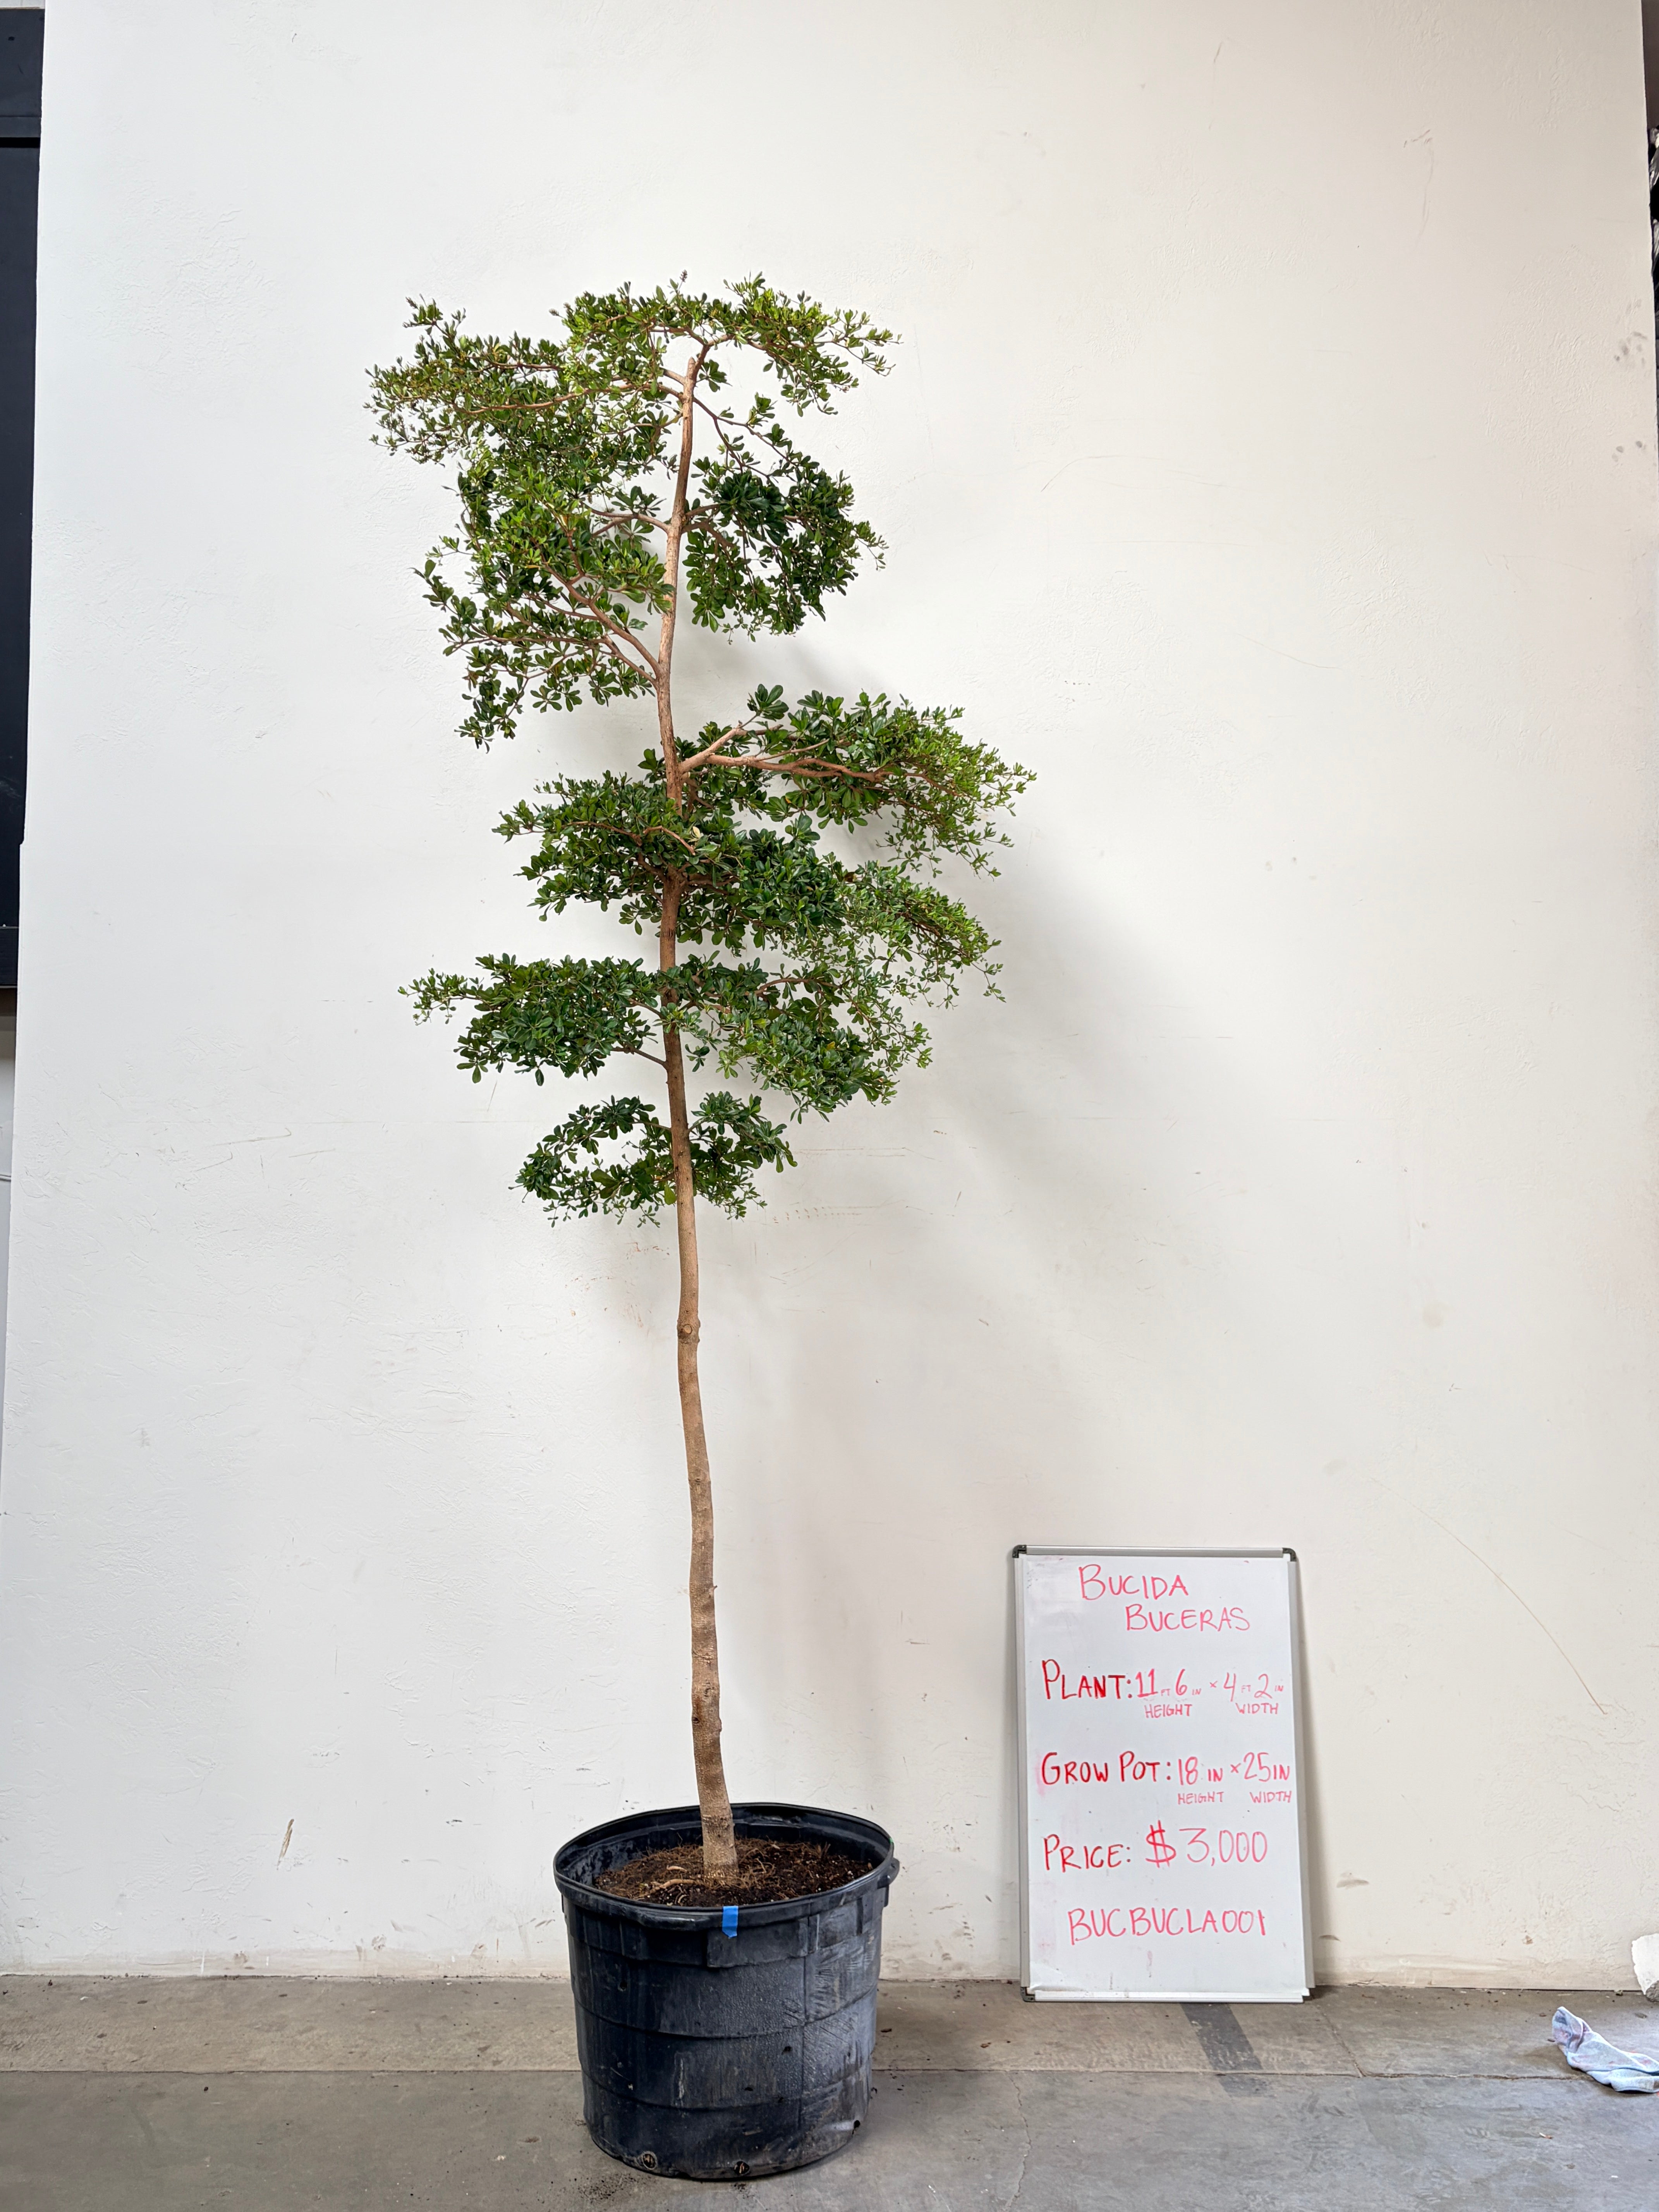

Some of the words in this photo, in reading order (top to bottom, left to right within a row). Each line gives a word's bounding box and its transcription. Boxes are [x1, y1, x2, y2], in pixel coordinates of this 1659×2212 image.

[1078, 1564, 1189, 1601] BUCIDA
[1125, 1603, 1250, 1633] BUCERAS
[1041, 1659, 1133, 1700] PLANT:
[1135, 1668, 1158, 1699] 11
[1175, 1668, 1188, 1697] 6
[1223, 1673, 1237, 1702] 4
[1254, 1673, 1272, 1699] 2
[1144, 1703, 1193, 1719] HEIGHT
[1235, 1702, 1279, 1715] WIDTH
[1041, 1752, 1109, 1785] GROW
[1177, 1756, 1199, 1786] 18
[1177, 1792, 1224, 1805] HEIGHT
[1249, 1791, 1292, 1803] WIDTH
[1043, 1834, 1132, 1874] PRICE:
[1067, 1907, 1266, 1946] BUCBUCLA001
